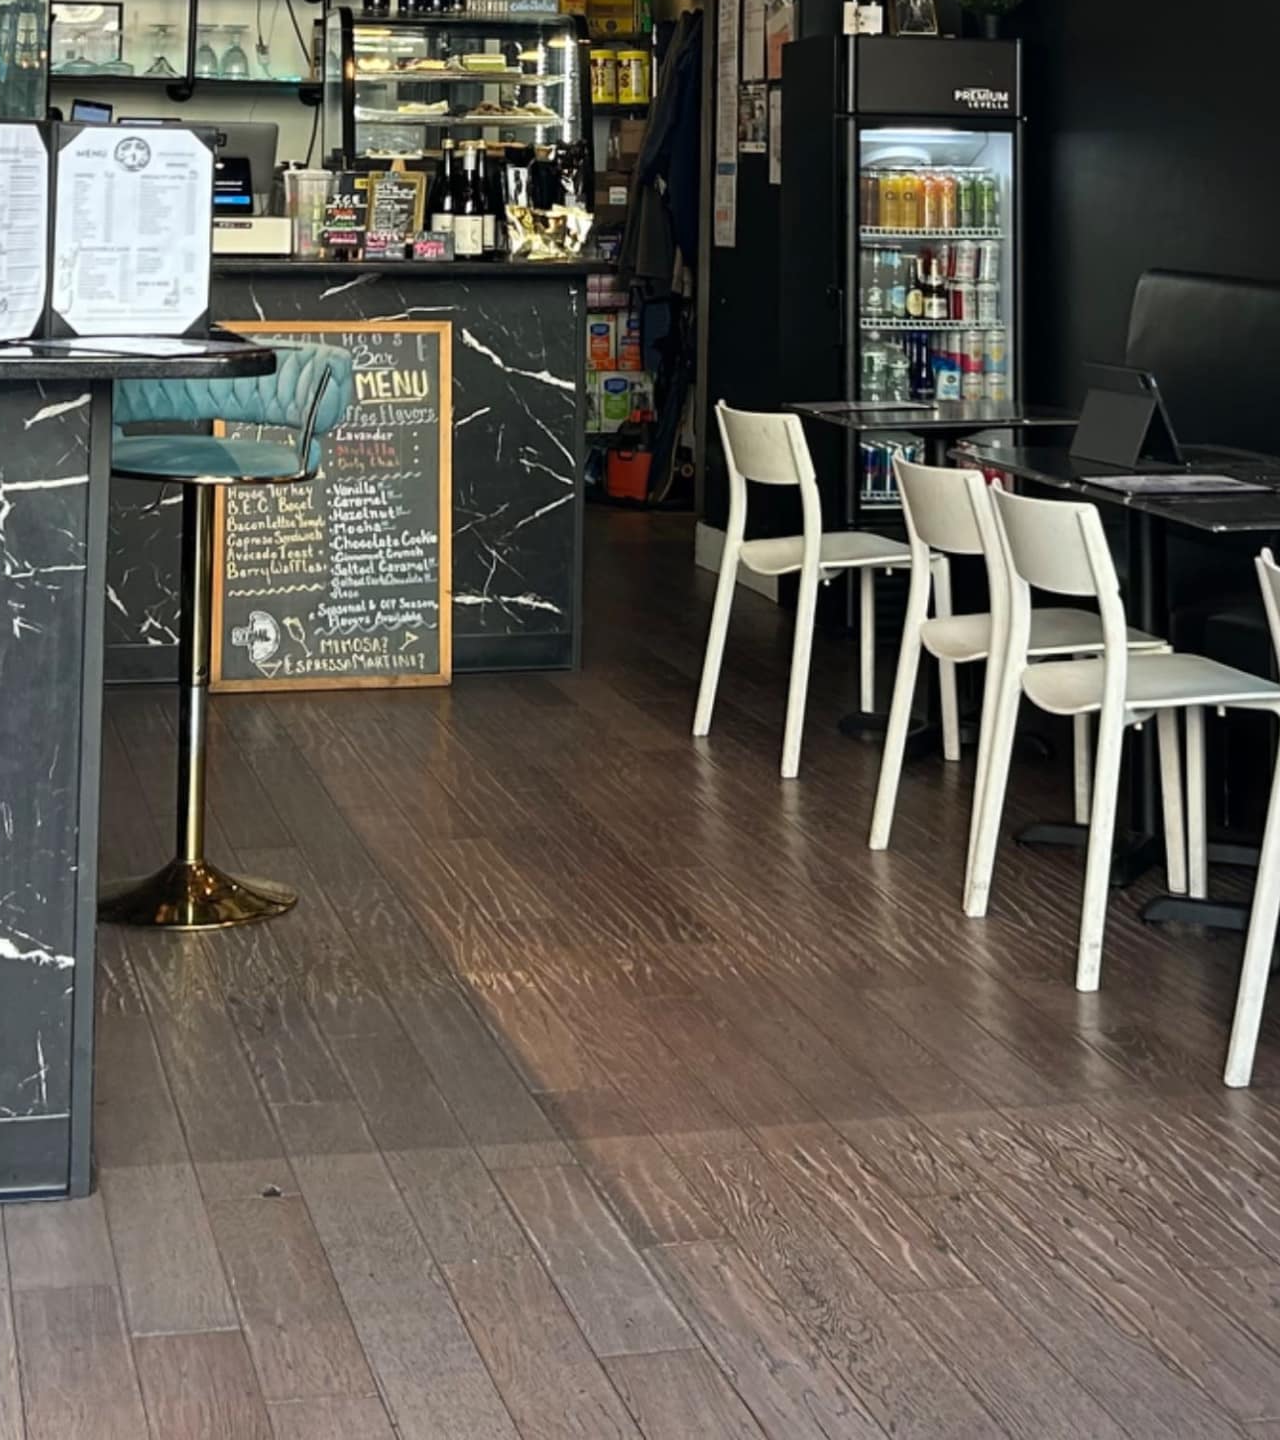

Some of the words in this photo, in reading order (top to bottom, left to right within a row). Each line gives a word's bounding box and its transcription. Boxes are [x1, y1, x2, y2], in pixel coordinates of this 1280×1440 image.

[954, 89, 1009, 103] PREMIUM
[351, 344, 399, 368] Bar
[354, 369, 429, 401] MENU
[227, 486, 265, 499] House
[333, 480, 377, 497] Vanilla
[333, 490, 388, 508] Caramel
[332, 506, 396, 521] Hazelnut
[227, 515, 265, 532] Bacon
[333, 520, 383, 535] Mocha
[333, 532, 401, 551] Chocolate
[401, 528, 438, 547] Cookie
[227, 546, 278, 561] Avocado
[278, 542, 314, 560] Toast
[334, 560, 375, 577] Salted
[378, 557, 429, 573] Caramel
[318, 599, 366, 617] Seasonal
[320, 636, 389, 654] MIMOSA?
